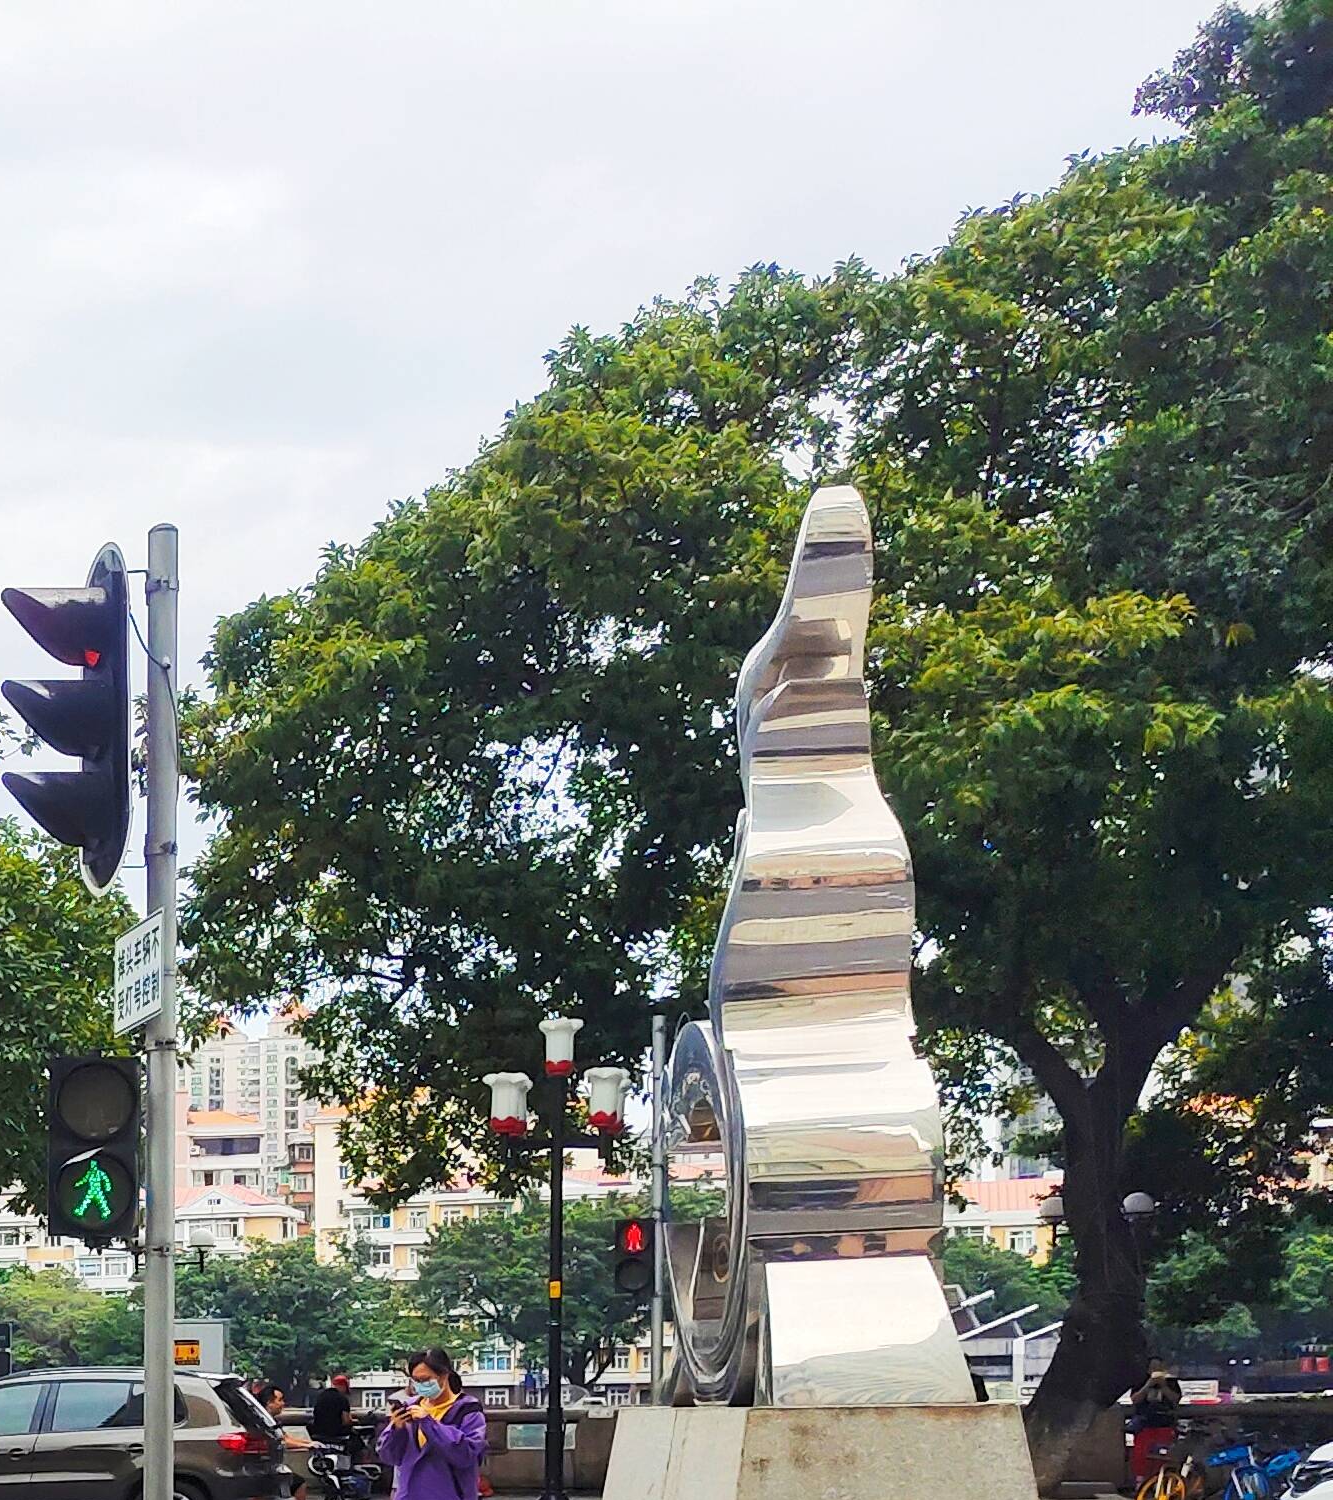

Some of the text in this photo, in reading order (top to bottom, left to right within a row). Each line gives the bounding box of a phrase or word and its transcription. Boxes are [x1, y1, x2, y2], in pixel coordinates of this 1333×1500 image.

[117, 967, 160, 1022] 受灯号控制
